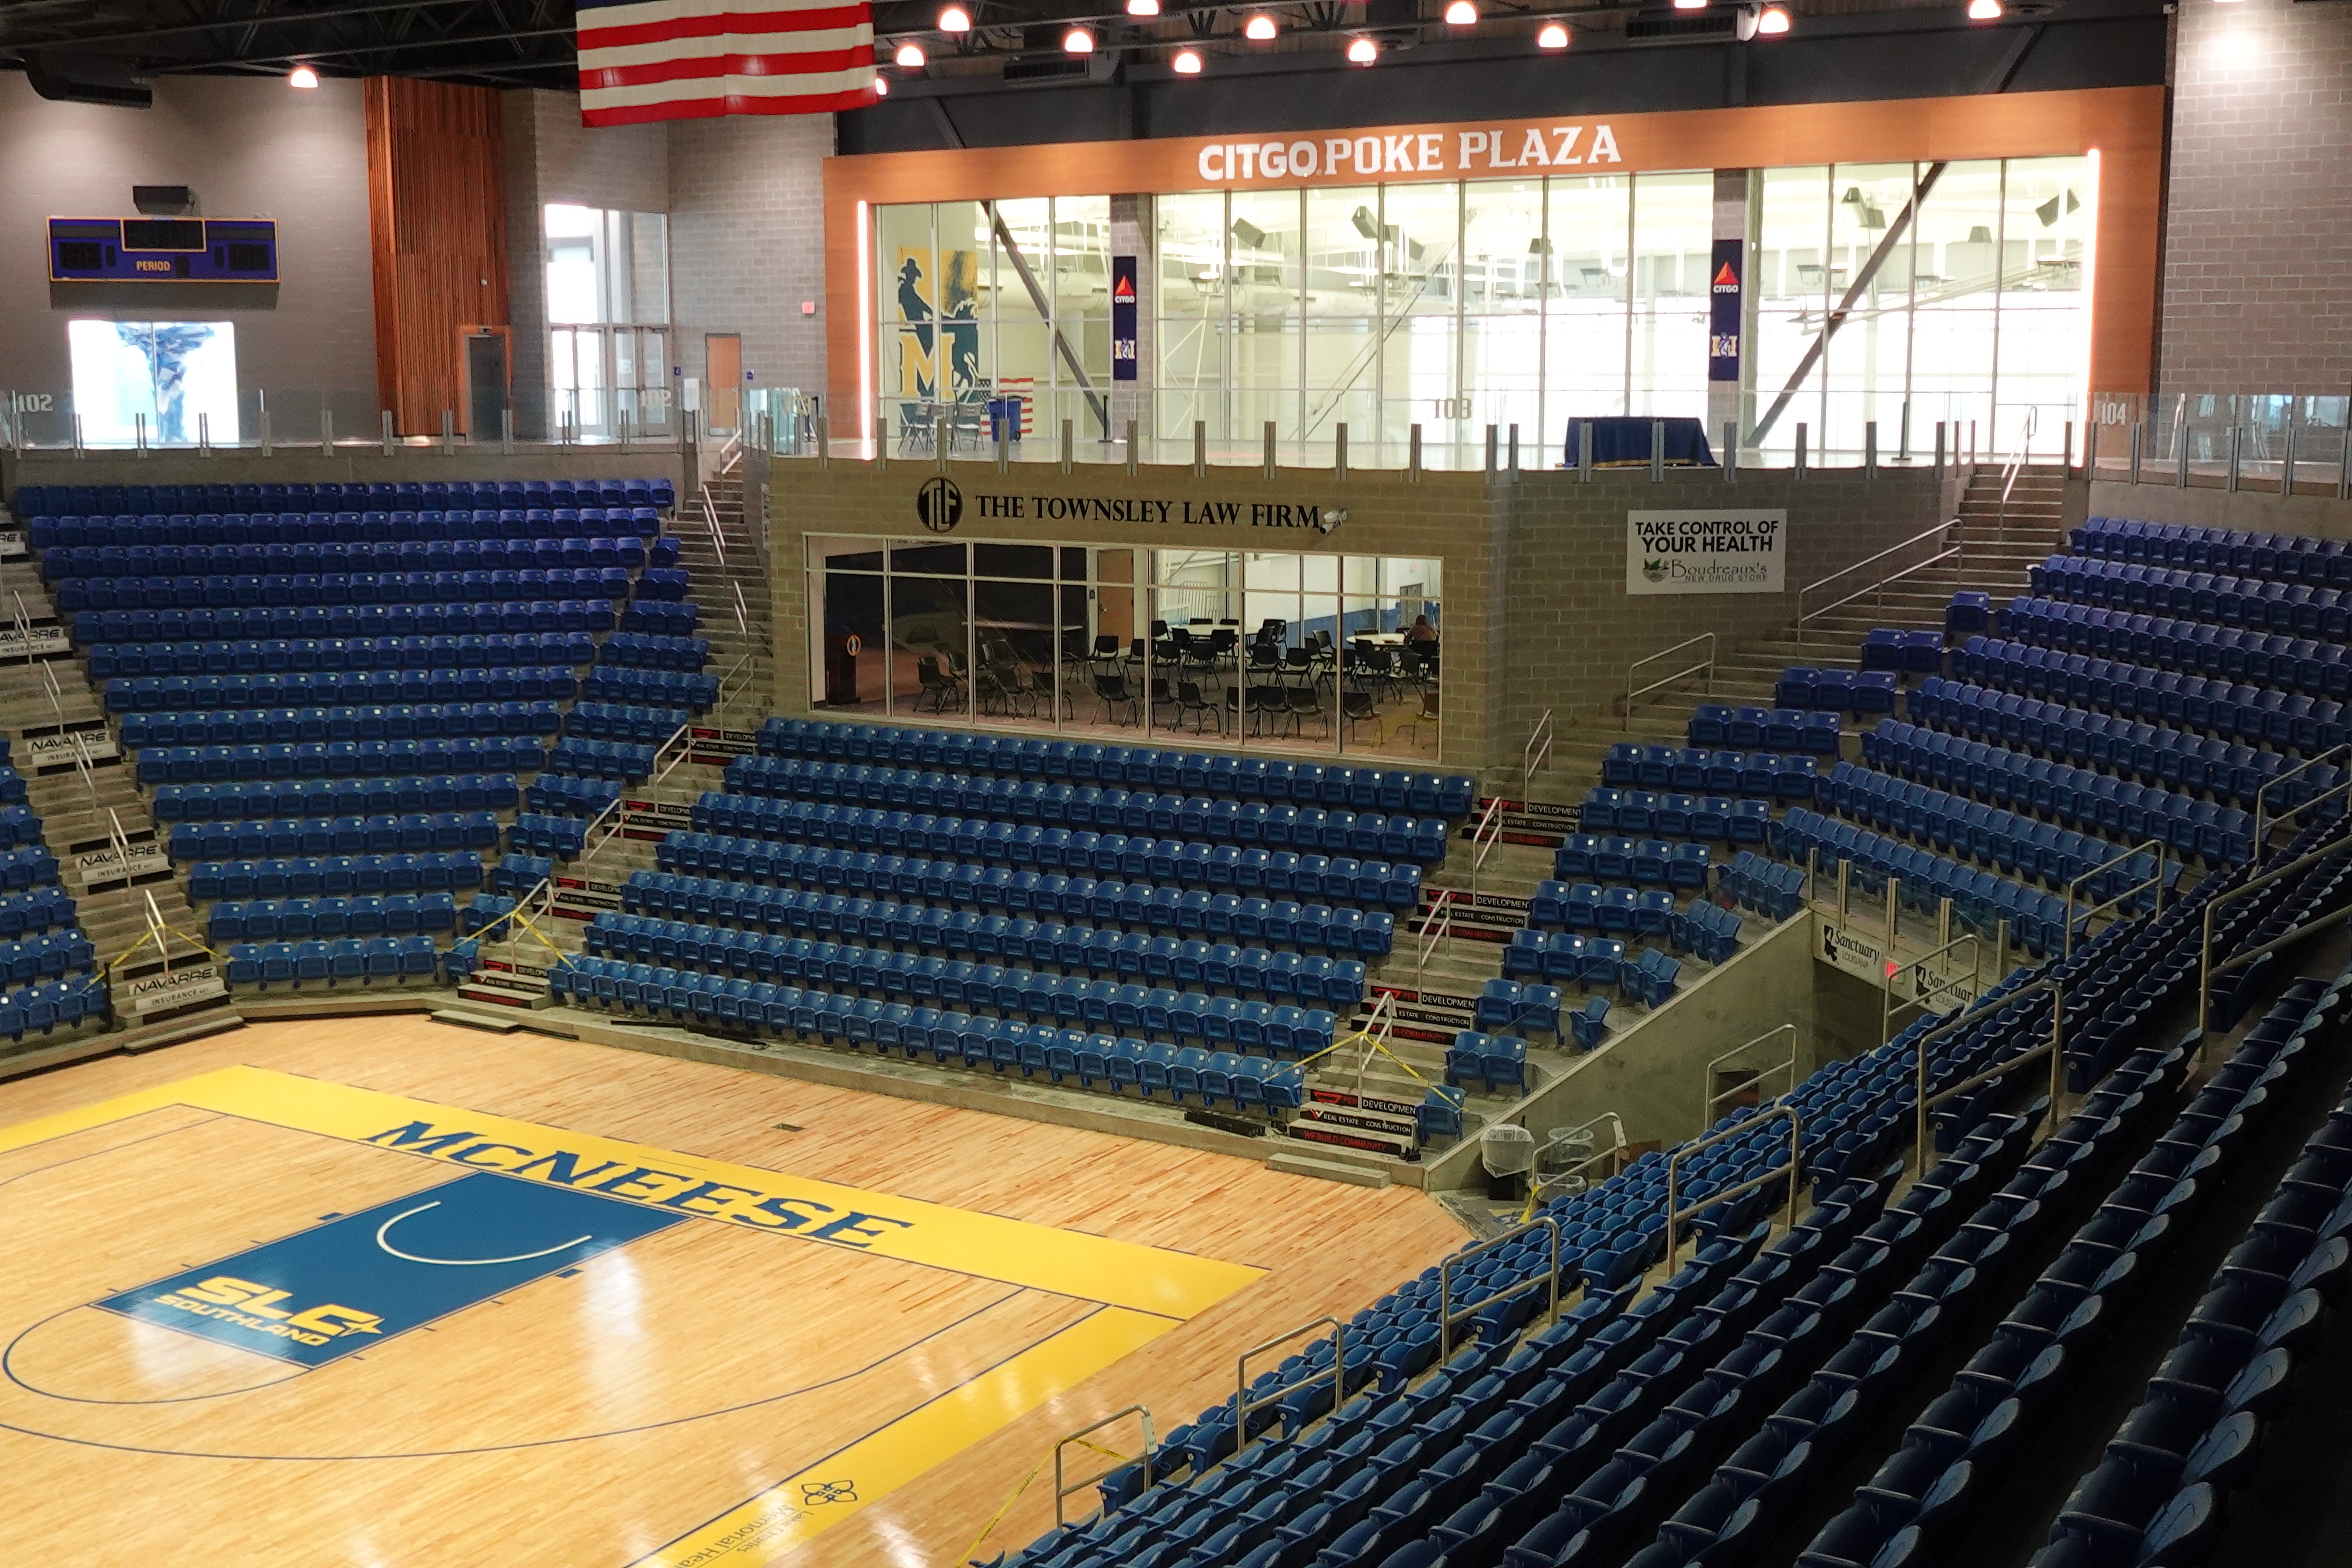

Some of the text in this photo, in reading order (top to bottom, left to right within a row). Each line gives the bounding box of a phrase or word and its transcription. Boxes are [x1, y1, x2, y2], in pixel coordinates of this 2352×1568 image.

[1198, 125, 1622, 181] CITGO POKE PLAZA
[136, 260, 170, 271] PERIOD
[1713, 285, 1739, 293] CITGO
[1115, 295, 1135, 303] CITGO
[18, 394, 53, 412] 102
[2101, 402, 2126, 426] 104
[976, 495, 1321, 529] THE TOWNSLEY LAW FIRM
[1635, 521, 1779, 536] TAKE CONTROL OF
[1642, 536, 1772, 553] YOUR HEALTH
[1672, 559, 1767, 578] Boudreaux's
[1481, 914, 1524, 925] CONSTRUCTION
[1835, 930, 1880, 965] Sanctuary
[134, 968, 213, 995] NAVARRE
[1422, 994, 1475, 1009] DEVELOPMEN
[1425, 1014, 1469, 1026] CONSTRUCTION
[1363, 1099, 1416, 1115] DEVELOPMEN
[1323, 1113, 1411, 1133] REAL ESTATE CONSTRUCTION
[175, 1275, 382, 1336] SLC
[153, 1293, 331, 1346] SOUTHLAND
[714, 1504, 796, 1549] Memorial
